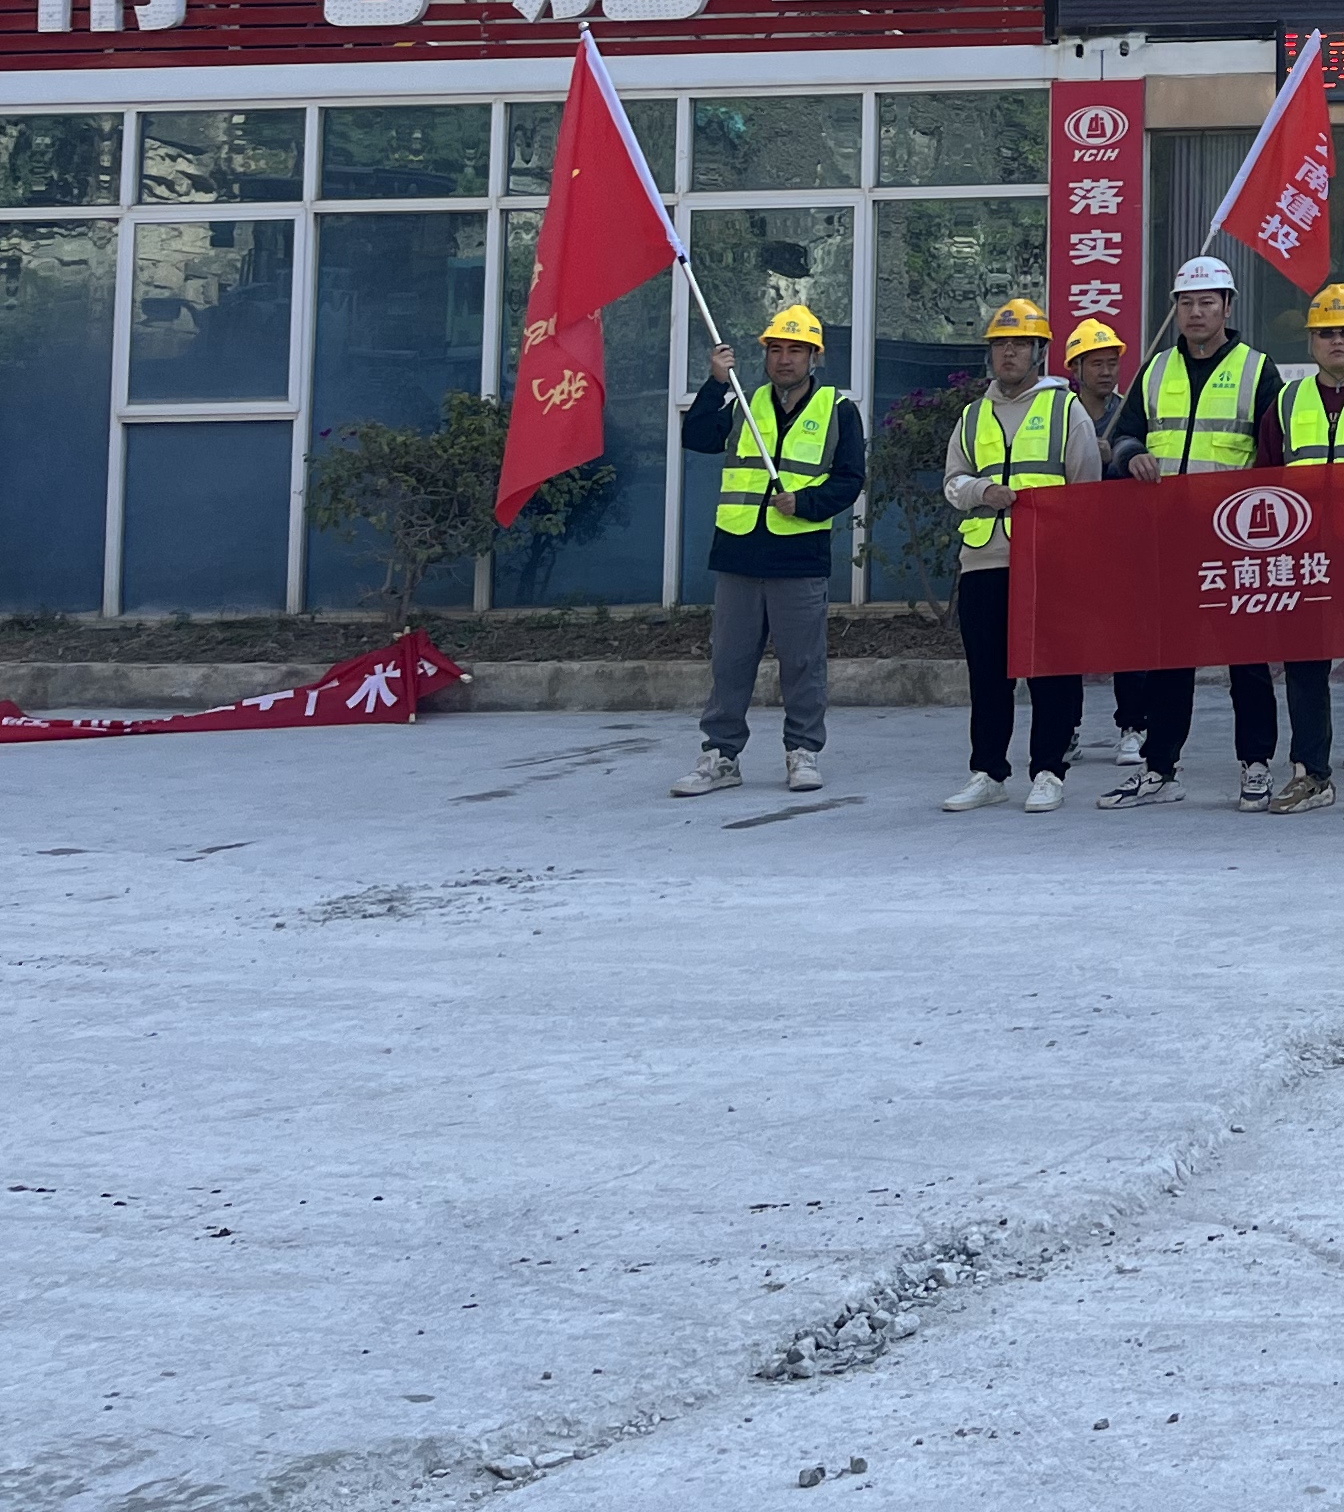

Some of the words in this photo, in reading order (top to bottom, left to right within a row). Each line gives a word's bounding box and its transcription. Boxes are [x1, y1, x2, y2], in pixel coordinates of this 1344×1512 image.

[1073, 148, 1121, 163] YCIH
[1198, 550, 1332, 592] 云南建投
[1230, 591, 1300, 615] YCIH
